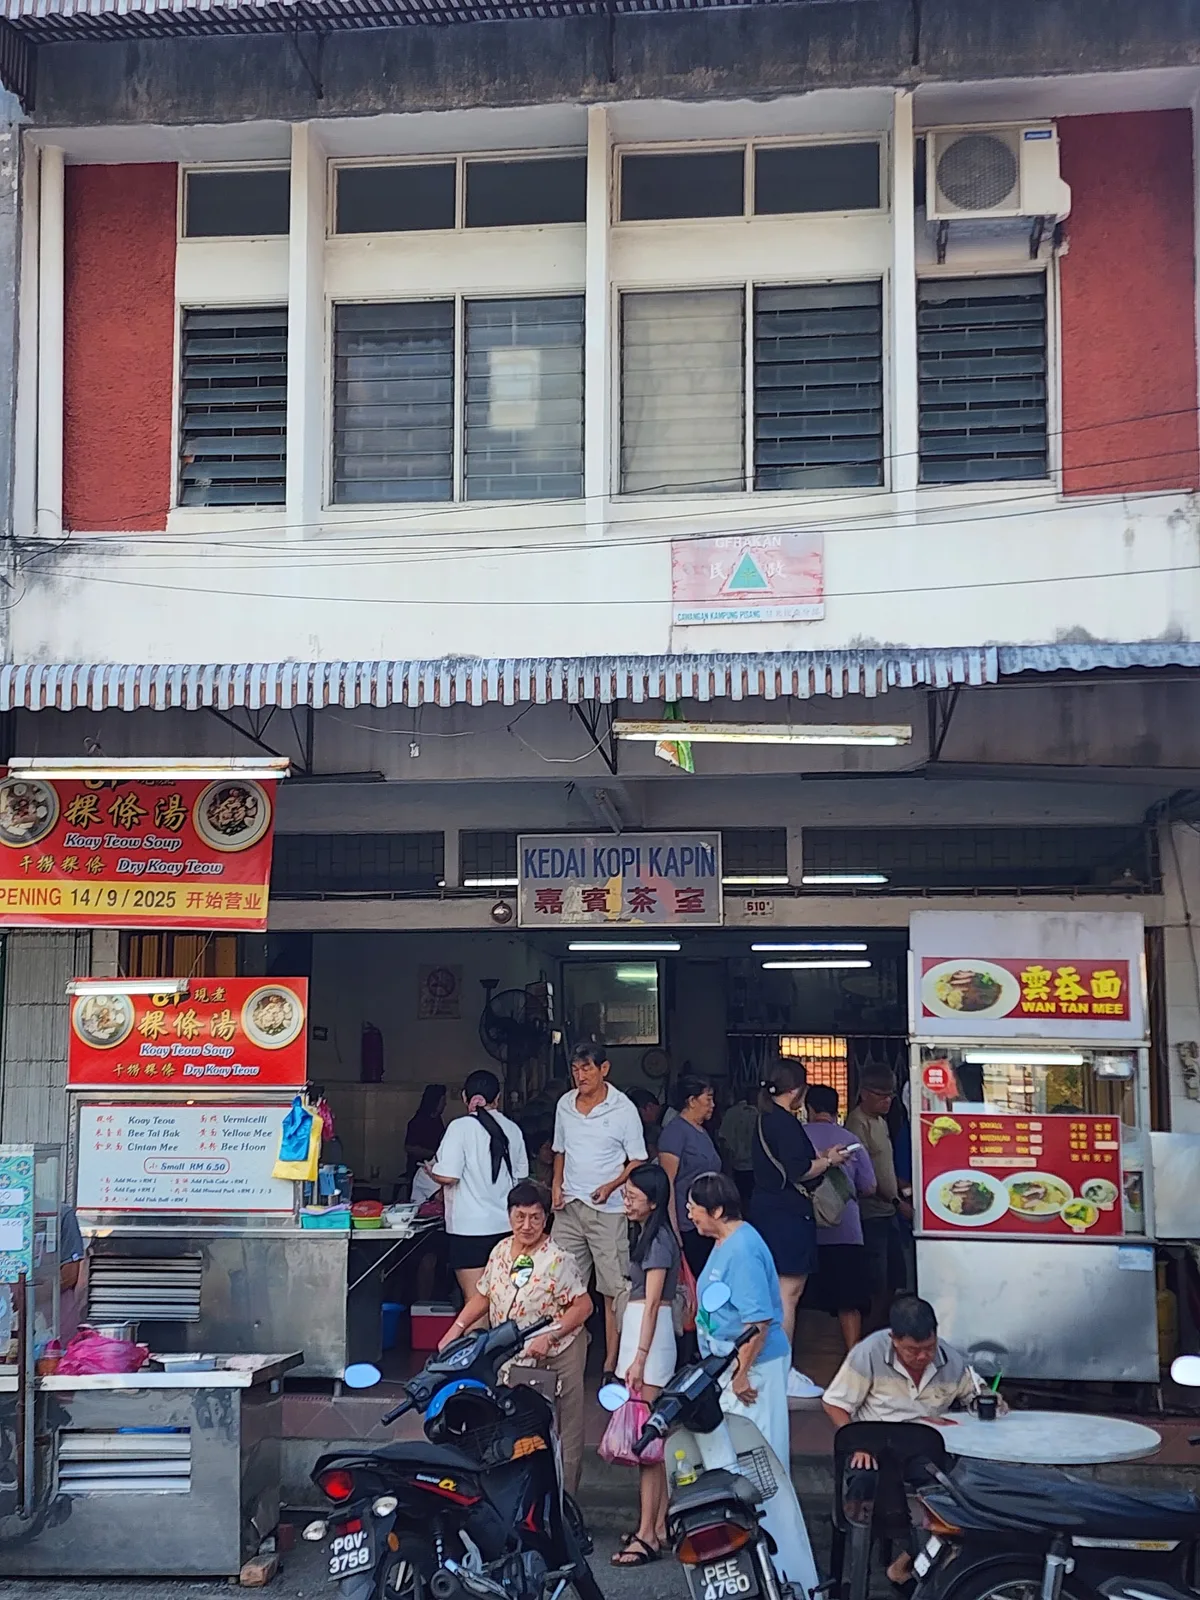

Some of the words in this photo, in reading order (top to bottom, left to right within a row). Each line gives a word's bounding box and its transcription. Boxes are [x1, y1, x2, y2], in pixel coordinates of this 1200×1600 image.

[710, 610, 738, 620] KAMPUNG
[739, 610, 761, 619] PISANG
[62, 794, 188, 831] 粿條湯
[64, 833, 101, 850] Koay
[103, 833, 141, 848] Teow
[144, 834, 182, 851] Soup
[117, 859, 149, 876] Dry
[147, 858, 184, 875] Koay
[186, 859, 223, 875] Teow
[524, 848, 585, 879] KEDAI
[593, 847, 641, 878] KOPI
[649, 845, 716, 878] KAPIN
[186, 891, 262, 911] 开始营业
[534, 886, 706, 915] 嘉賓茶室
[1020, 965, 1122, 1002] 雲吞面
[1022, 1001, 1056, 1014] WAN
[1059, 1002, 1089, 1014] TAN
[1092, 1003, 1124, 1015] MEE
[137, 1008, 238, 1041] 粿條湯
[140, 1043, 170, 1059] Koay
[171, 1043, 201, 1056] Teow
[202, 1043, 234, 1059] Soup
[183, 1063, 205, 1078] Dry
[205, 1064, 233, 1078] Koay
[232, 1065, 260, 1076] Teow
[127, 1115, 150, 1126] Koay
[153, 1116, 176, 1125] Teow
[222, 1115, 268, 1124] Vermicelli
[127, 1128, 145, 1138] Bee
[162, 1128, 180, 1138] Bak
[221, 1129, 251, 1138] Yellow
[253, 1129, 273, 1138] Mee
[160, 1143, 179, 1152] Mee
[221, 1143, 239, 1151] Bee
[240, 1143, 266, 1151] Hoon
[160, 1162, 185, 1171] Small
[189, 1163, 204, 1171] RM
[206, 1163, 226, 1171] 6.50
[329, 1547, 370, 1574] 3758
[703, 1559, 740, 1582] PEE
[704, 1574, 750, 1600] 4760
